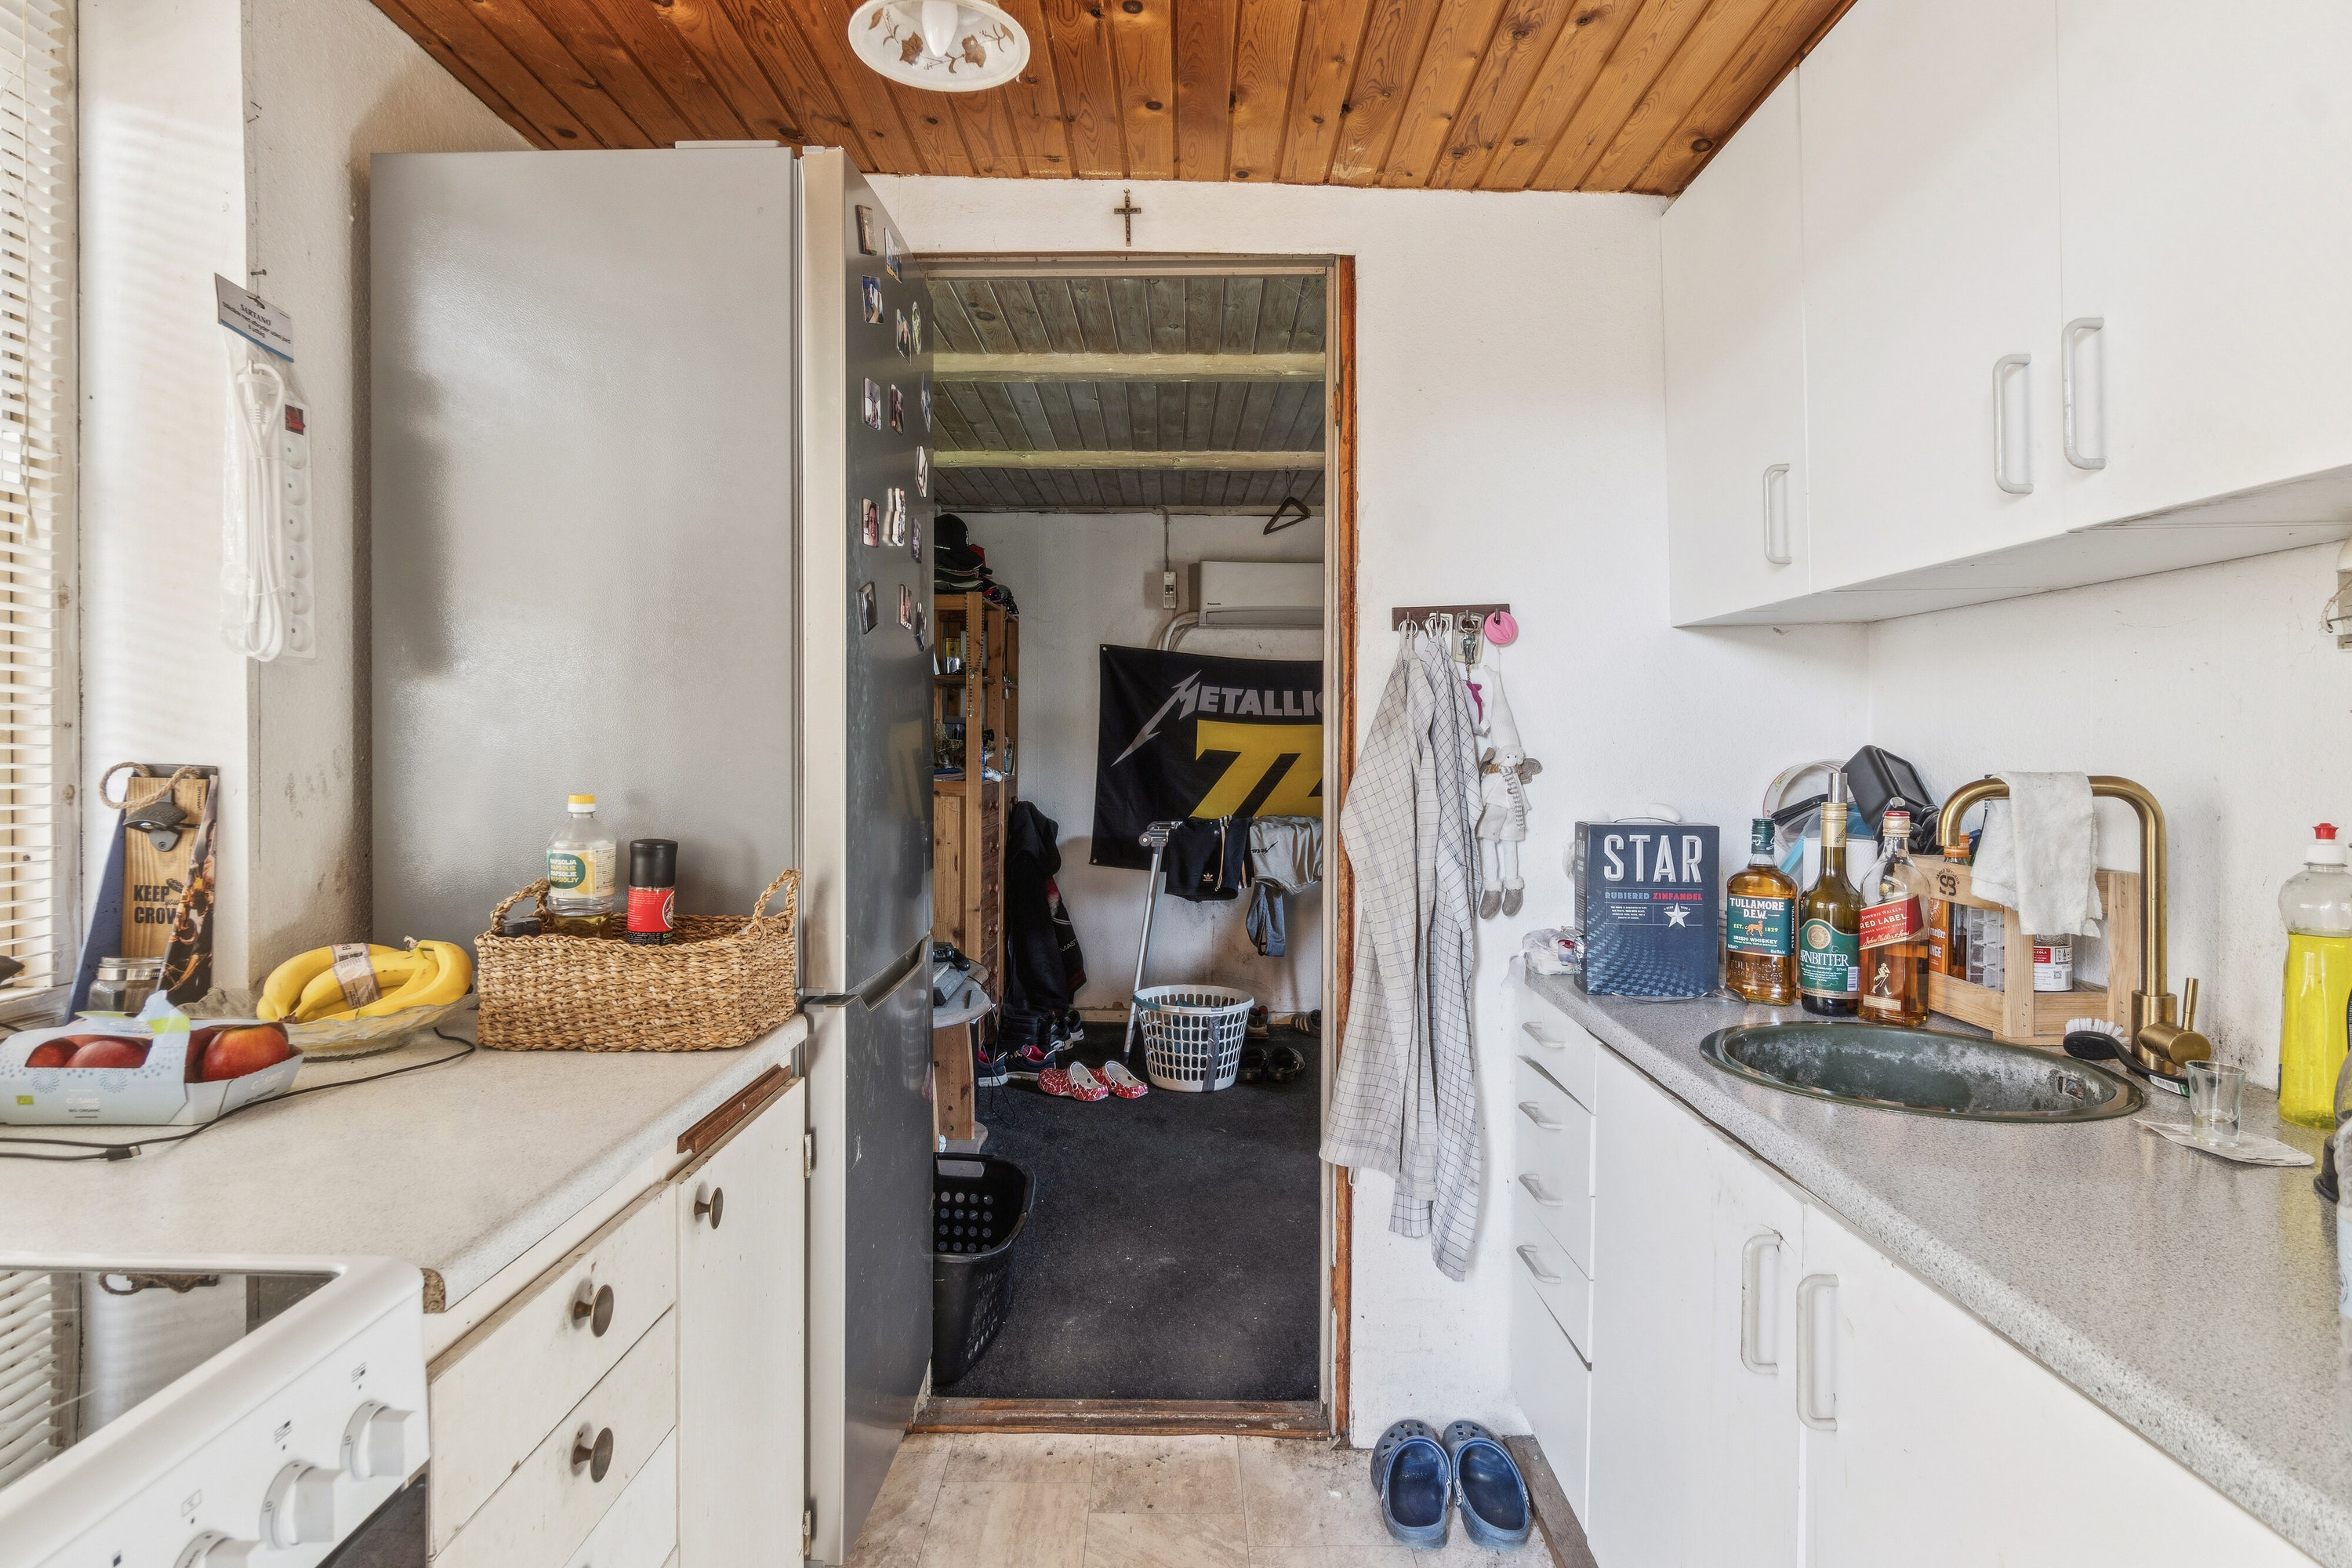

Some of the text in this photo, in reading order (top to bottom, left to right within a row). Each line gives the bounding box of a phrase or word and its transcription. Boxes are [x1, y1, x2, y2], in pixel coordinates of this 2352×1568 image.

[240, 303, 271, 326] SARTANO
[1603, 834, 1703, 884] STAR
[133, 884, 170, 902] KEEP
[1604, 891, 1703, 901] RUBIERED ZINFANDEL
[1729, 897, 1785, 911] TULLAMORE
[134, 906, 178, 924] CROW
[1742, 908, 1768, 920] D.E.W.
[1860, 913, 1907, 930] RED LABEL
[1861, 907, 1904, 921] JOHNNIE WALKER
[1929, 927, 1947, 940] meister
[1929, 944, 1943, 958] NGE
[251, 1069, 286, 1090] CSMIC
